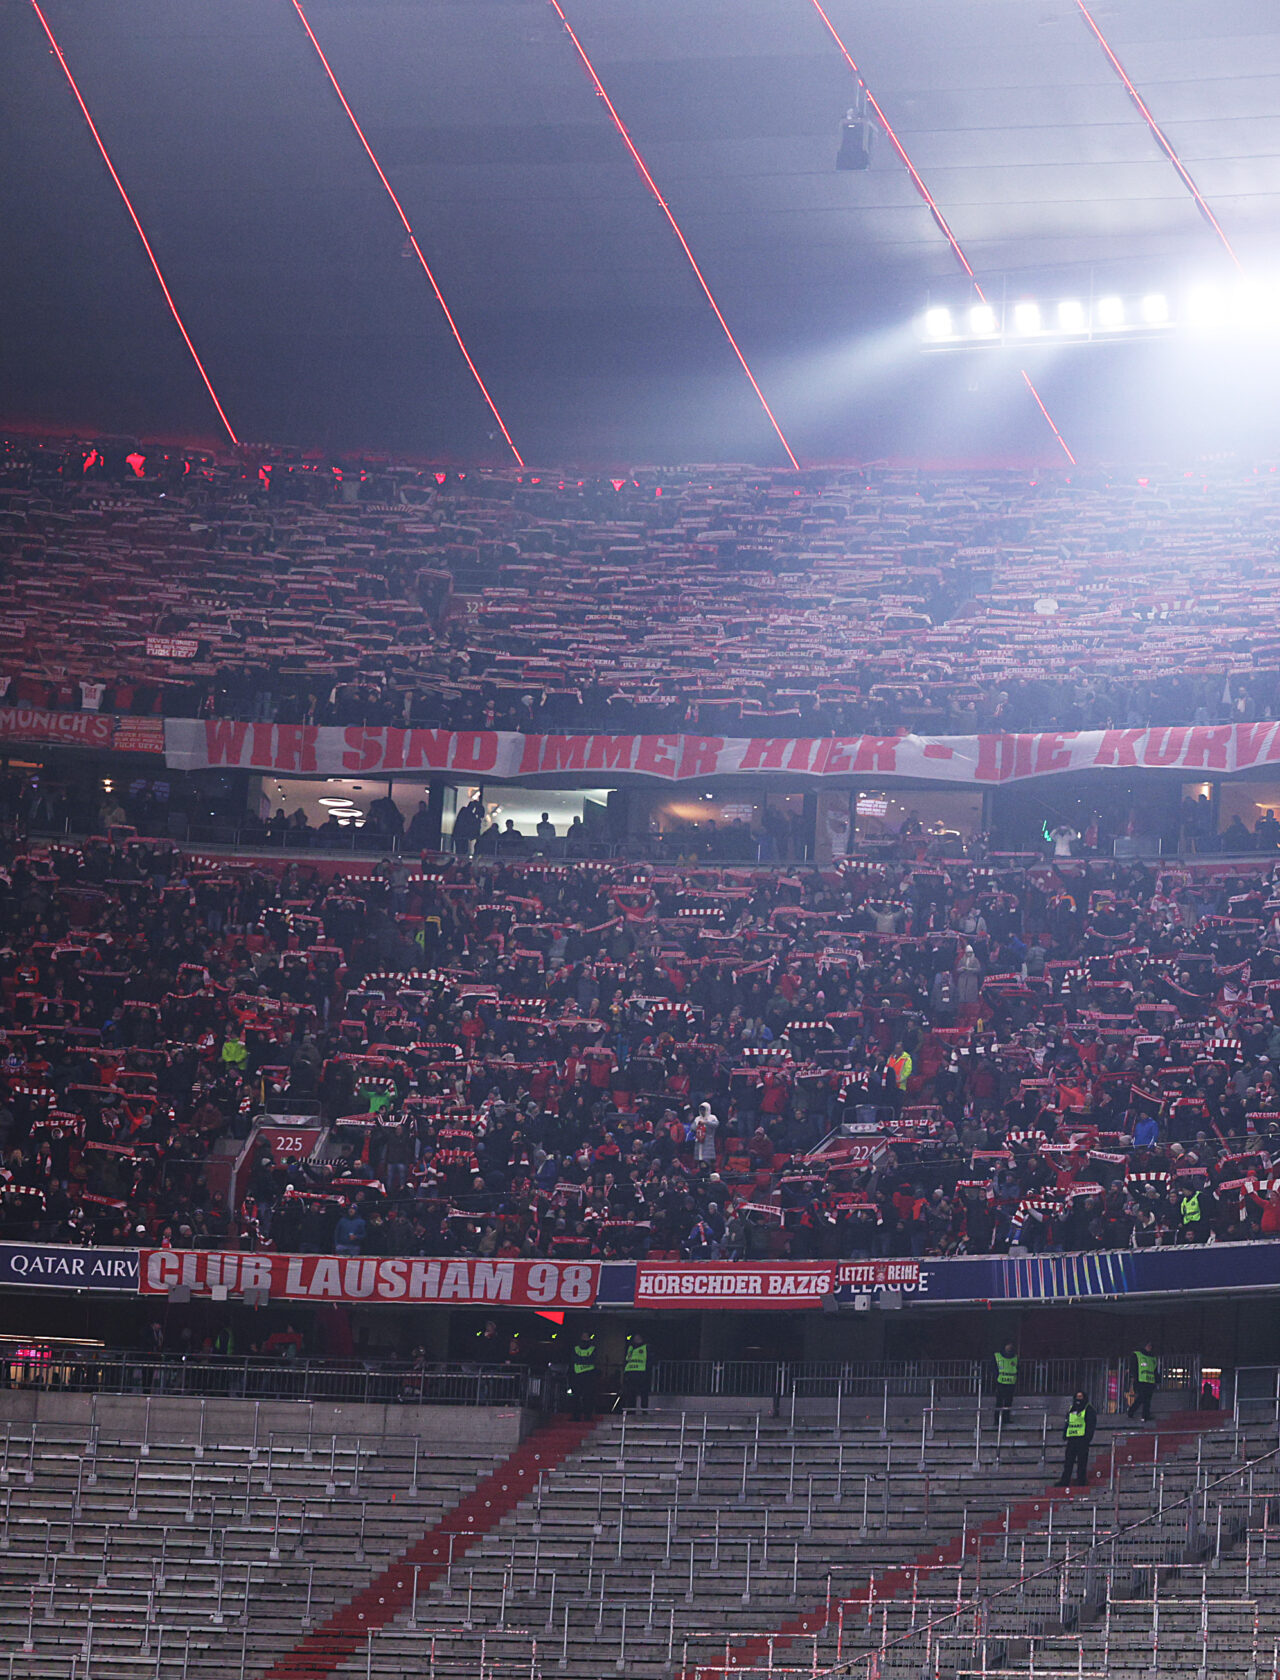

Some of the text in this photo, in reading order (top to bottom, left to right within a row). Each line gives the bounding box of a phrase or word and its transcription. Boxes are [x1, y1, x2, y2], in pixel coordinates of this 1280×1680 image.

[205, 720, 318, 772] WIR
[343, 729, 499, 773] SIND
[519, 734, 725, 779] IMMER
[739, 735, 899, 776] HIER
[974, 731, 1080, 780] DIE
[276, 1137, 302, 1151] 225
[10, 1254, 85, 1276] QATAR
[840, 1265, 918, 1281] LETZTE REIHE
[147, 1252, 594, 1302] CLUB LAUSHAM 98
[639, 1273, 830, 1294] HÖRSCHDER BAZIS
